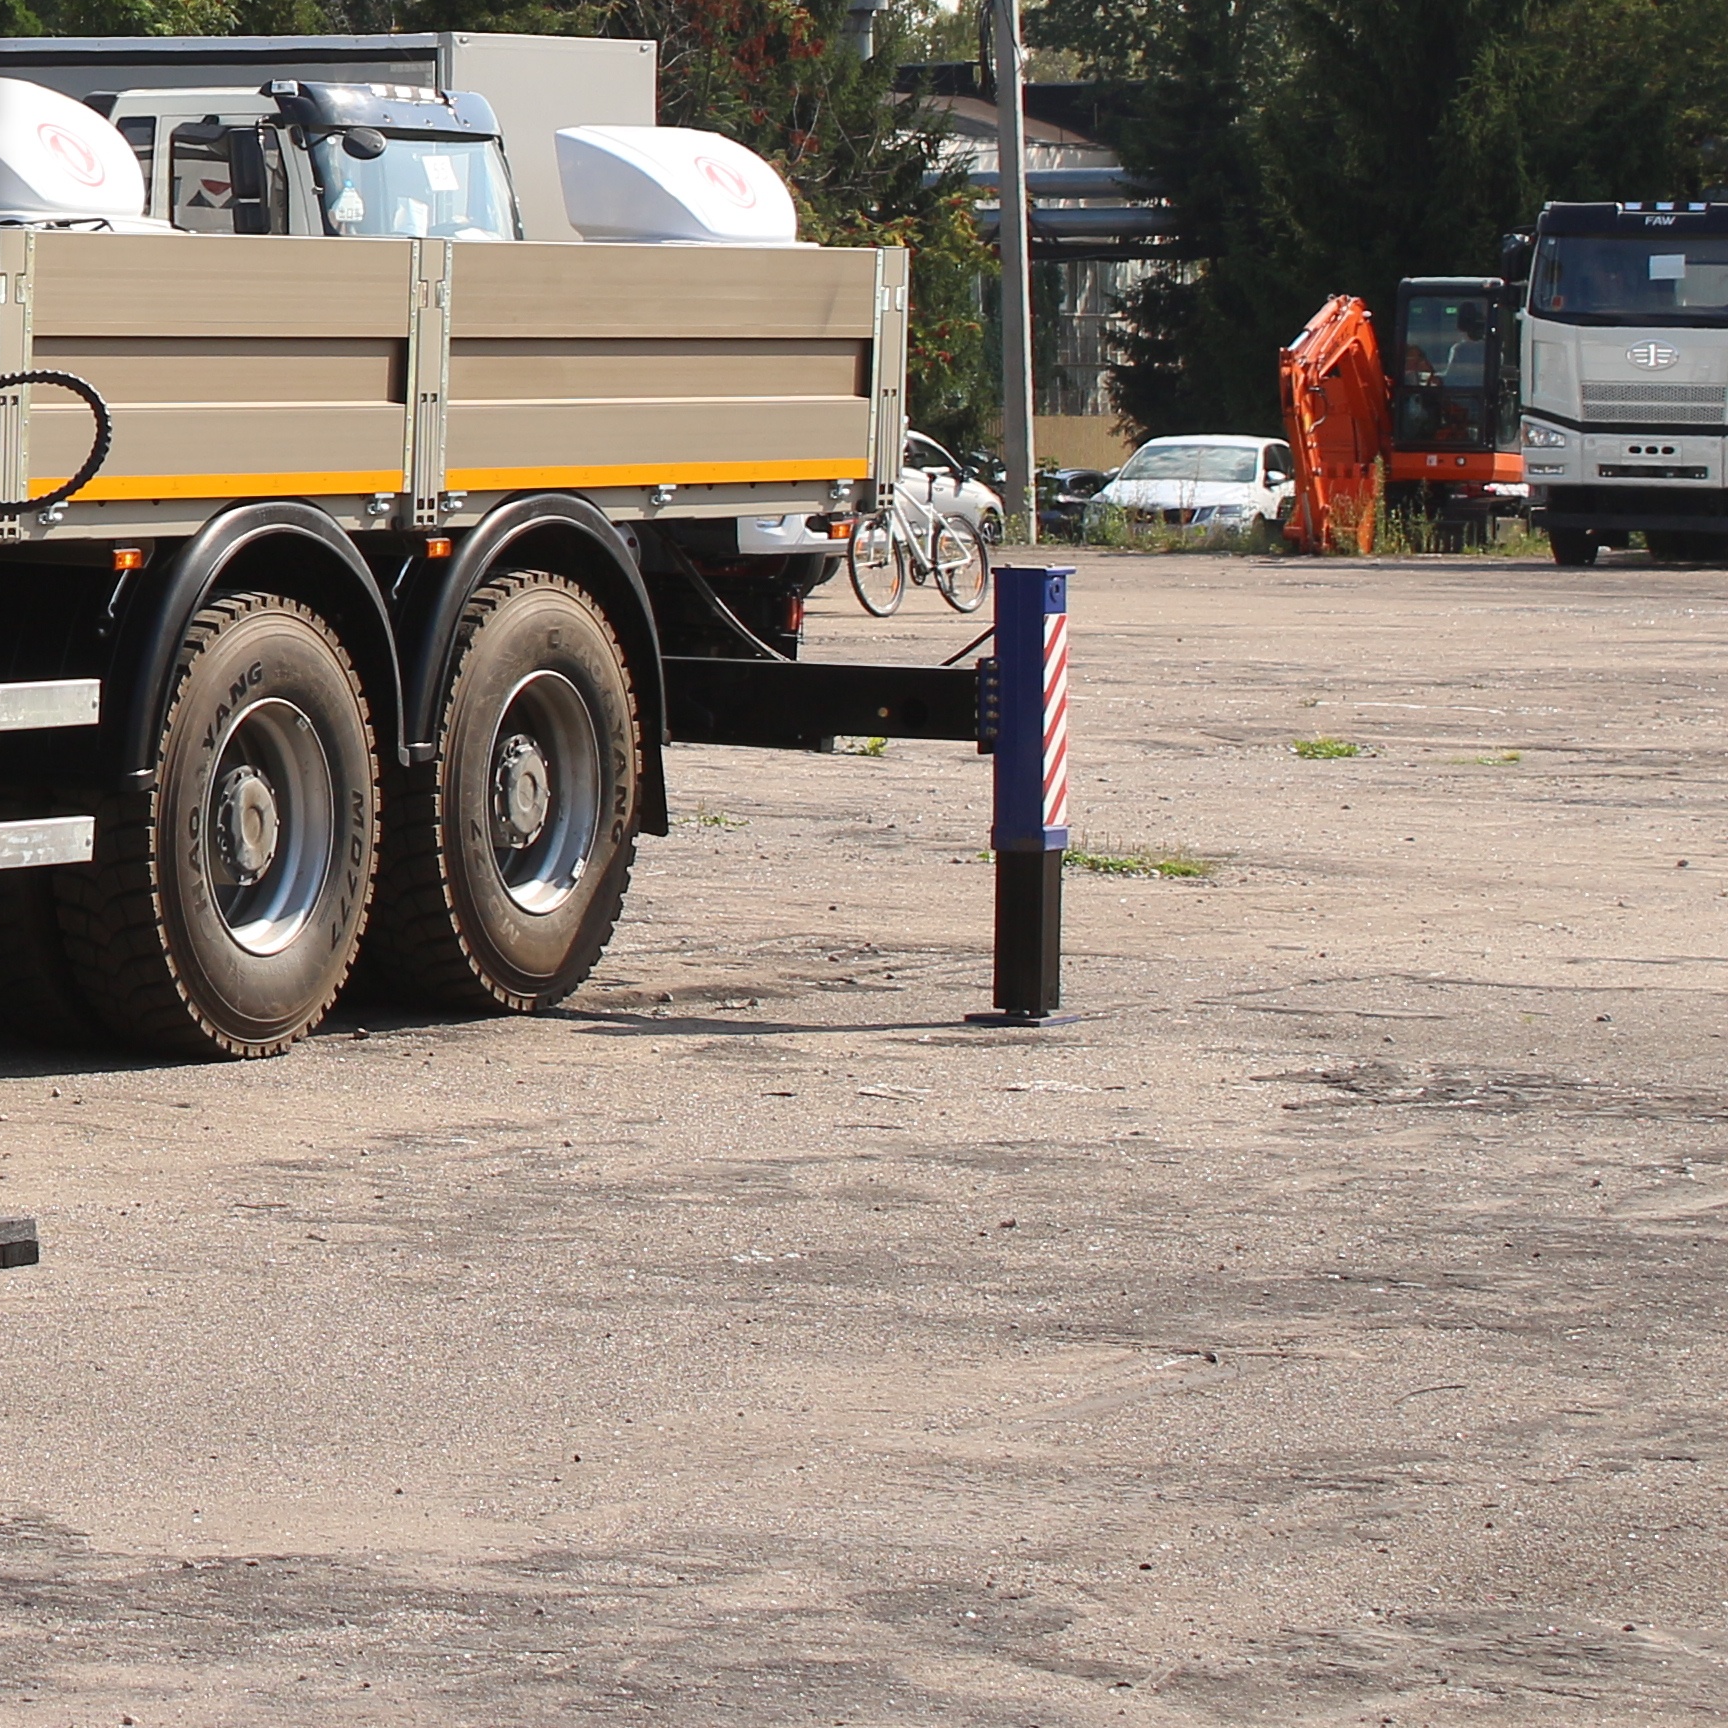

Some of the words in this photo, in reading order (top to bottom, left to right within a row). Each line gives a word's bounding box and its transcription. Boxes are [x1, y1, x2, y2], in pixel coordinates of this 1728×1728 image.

[1645, 215, 1677, 226] FAW
[201, 660, 263, 751] YANG
[610, 719, 628, 846] YANG
[329, 789, 365, 952] MD777
